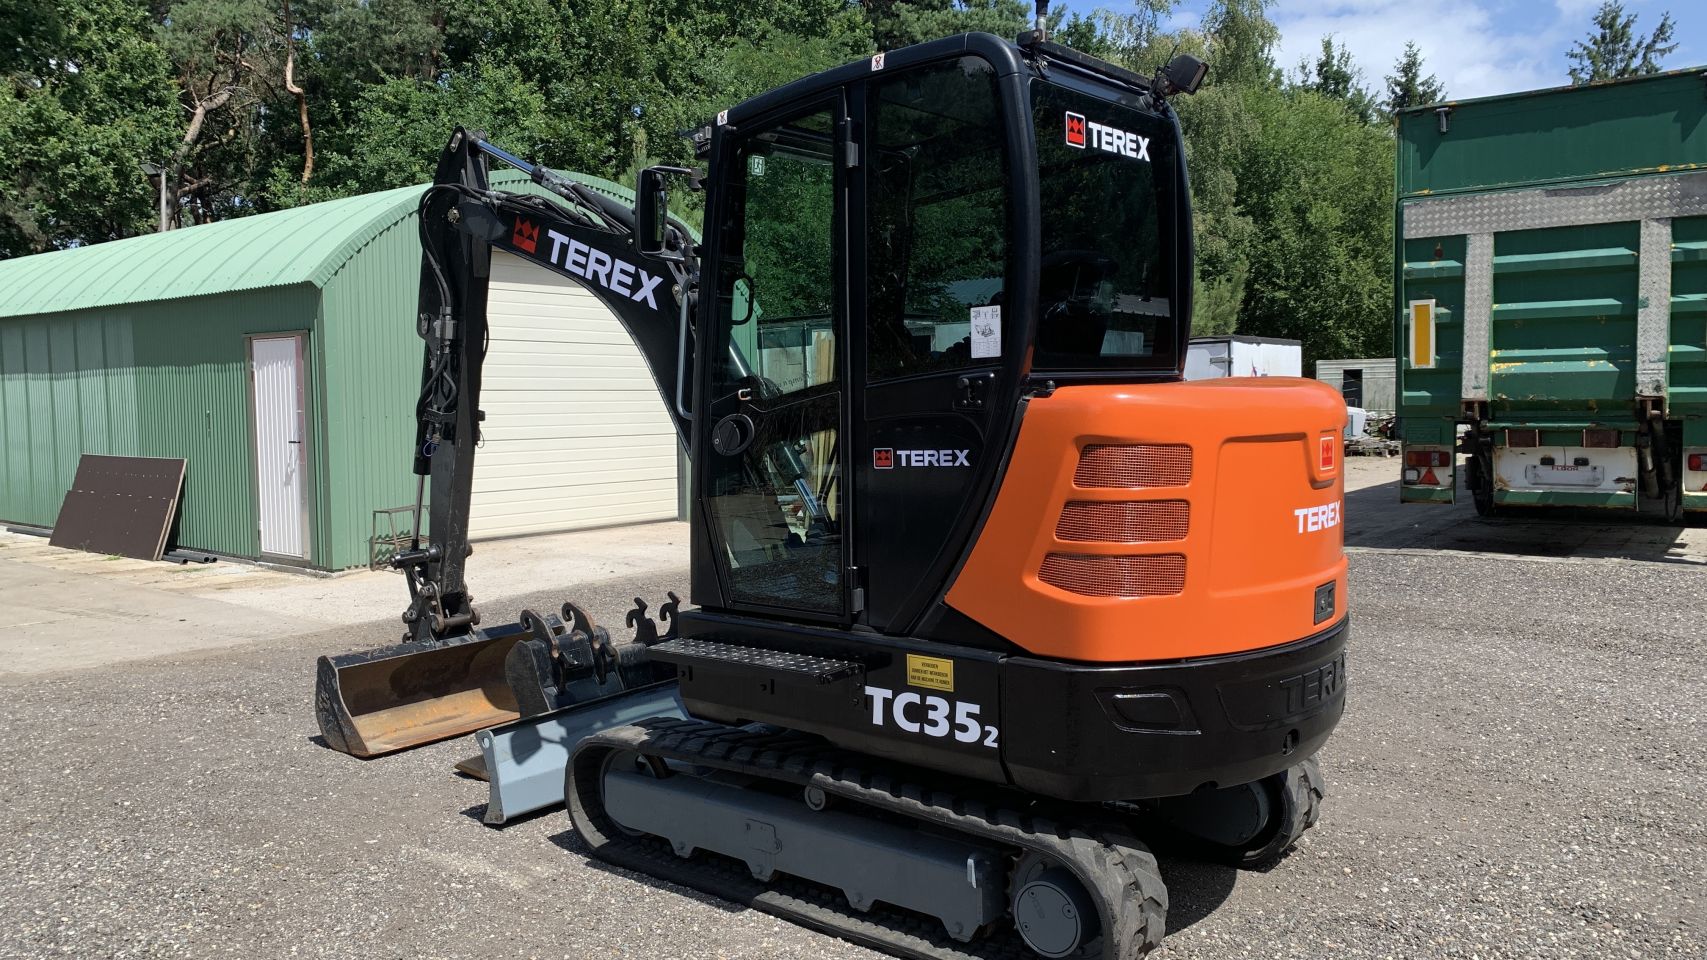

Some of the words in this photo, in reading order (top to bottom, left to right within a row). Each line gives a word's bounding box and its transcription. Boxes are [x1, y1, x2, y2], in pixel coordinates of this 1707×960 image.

[1088, 121, 1151, 162] TEREX
[547, 228, 664, 311] TEREX
[896, 449, 971, 467] TEREX
[1294, 500, 1341, 534] TEREX
